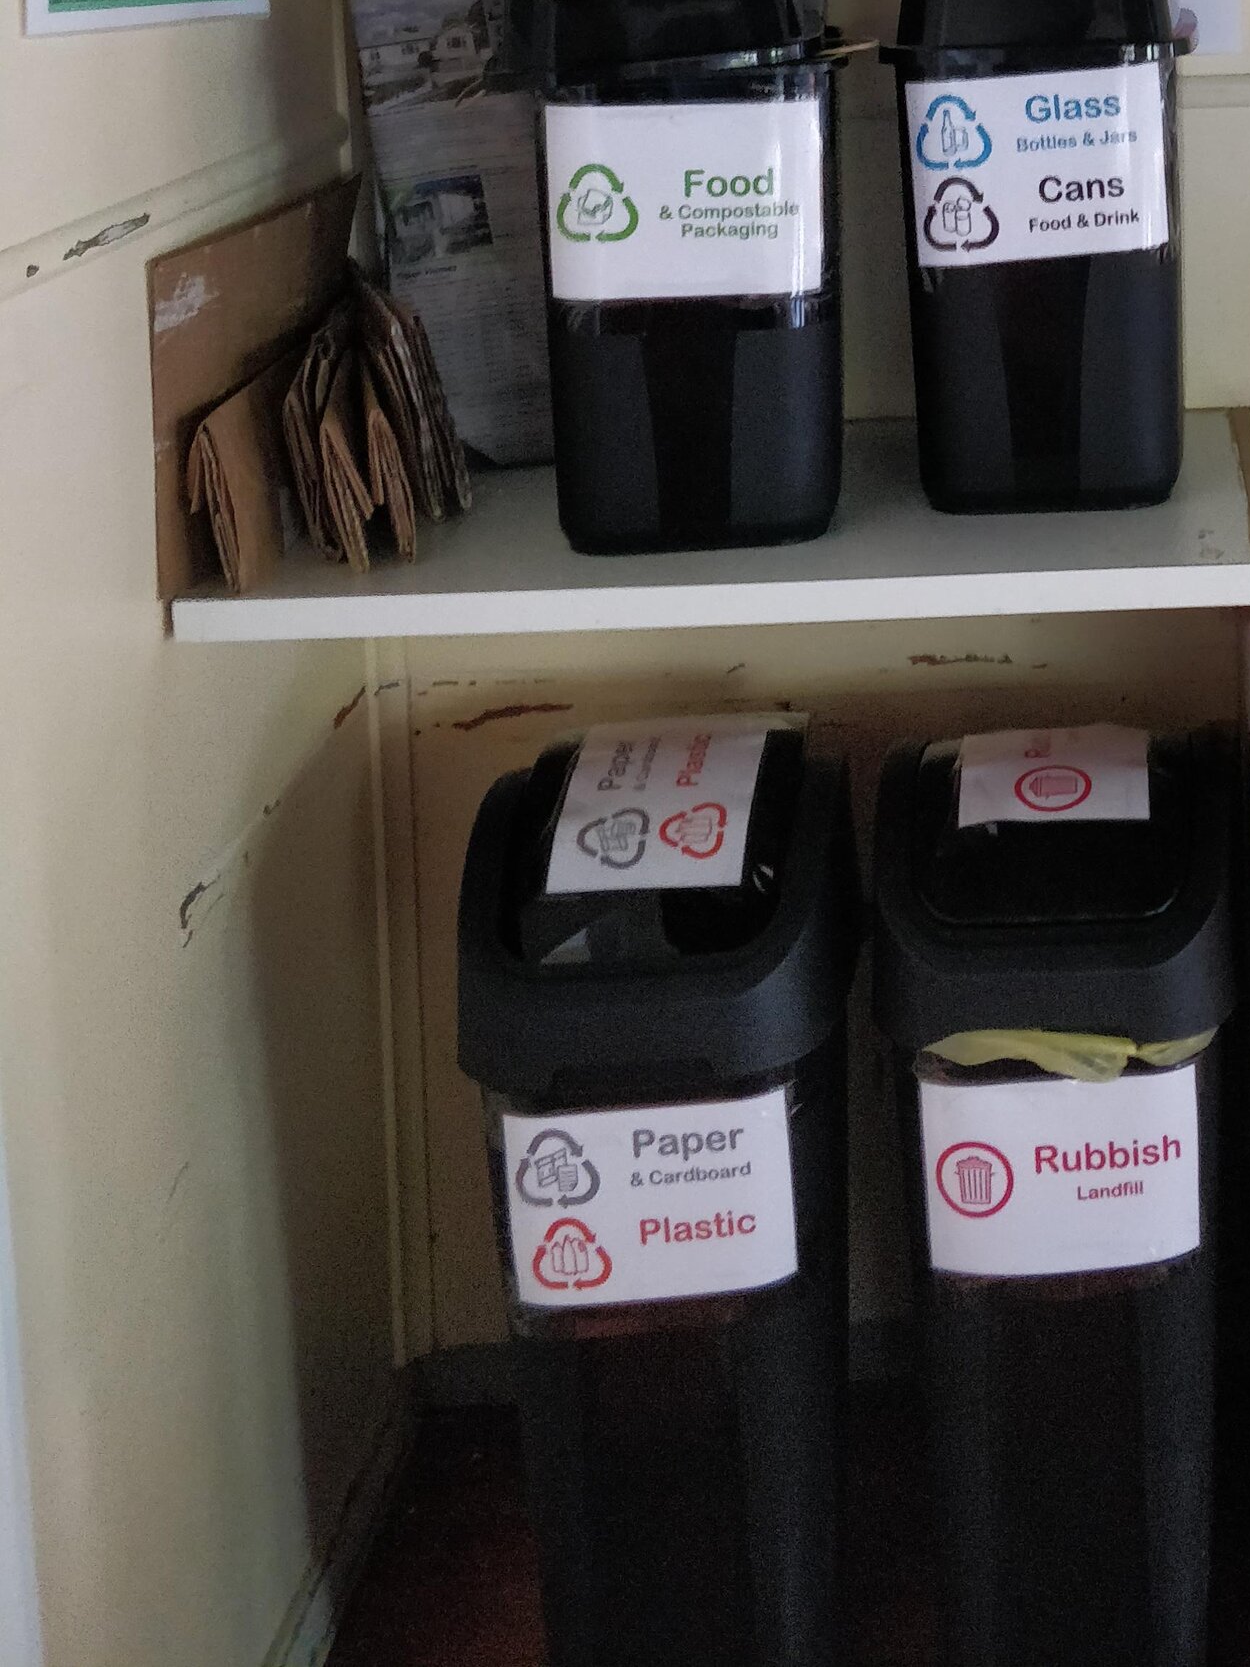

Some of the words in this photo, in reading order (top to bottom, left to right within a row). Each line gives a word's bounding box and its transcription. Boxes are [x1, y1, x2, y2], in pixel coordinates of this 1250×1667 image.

[1025, 94, 1121, 123] Glass
[1016, 136, 1077, 153] Bottles
[1083, 132, 1096, 147] &
[1099, 129, 1138, 146] Jars
[683, 167, 775, 198] Food
[1038, 175, 1126, 203] Cans
[659, 205, 673, 220] &
[678, 202, 801, 221] Compostable
[1028, 214, 1072, 233] Food
[1077, 213, 1090, 228] &
[1094, 209, 1140, 227] Drink
[680, 222, 779, 240] Packaging
[631, 1127, 744, 1162] Paper
[1034, 1135, 1182, 1175] Rubbish
[630, 1172, 644, 1187] &
[649, 1161, 752, 1185] Cardboard
[1077, 1181, 1144, 1201] Landfill
[639, 1210, 757, 1246] Plastic
